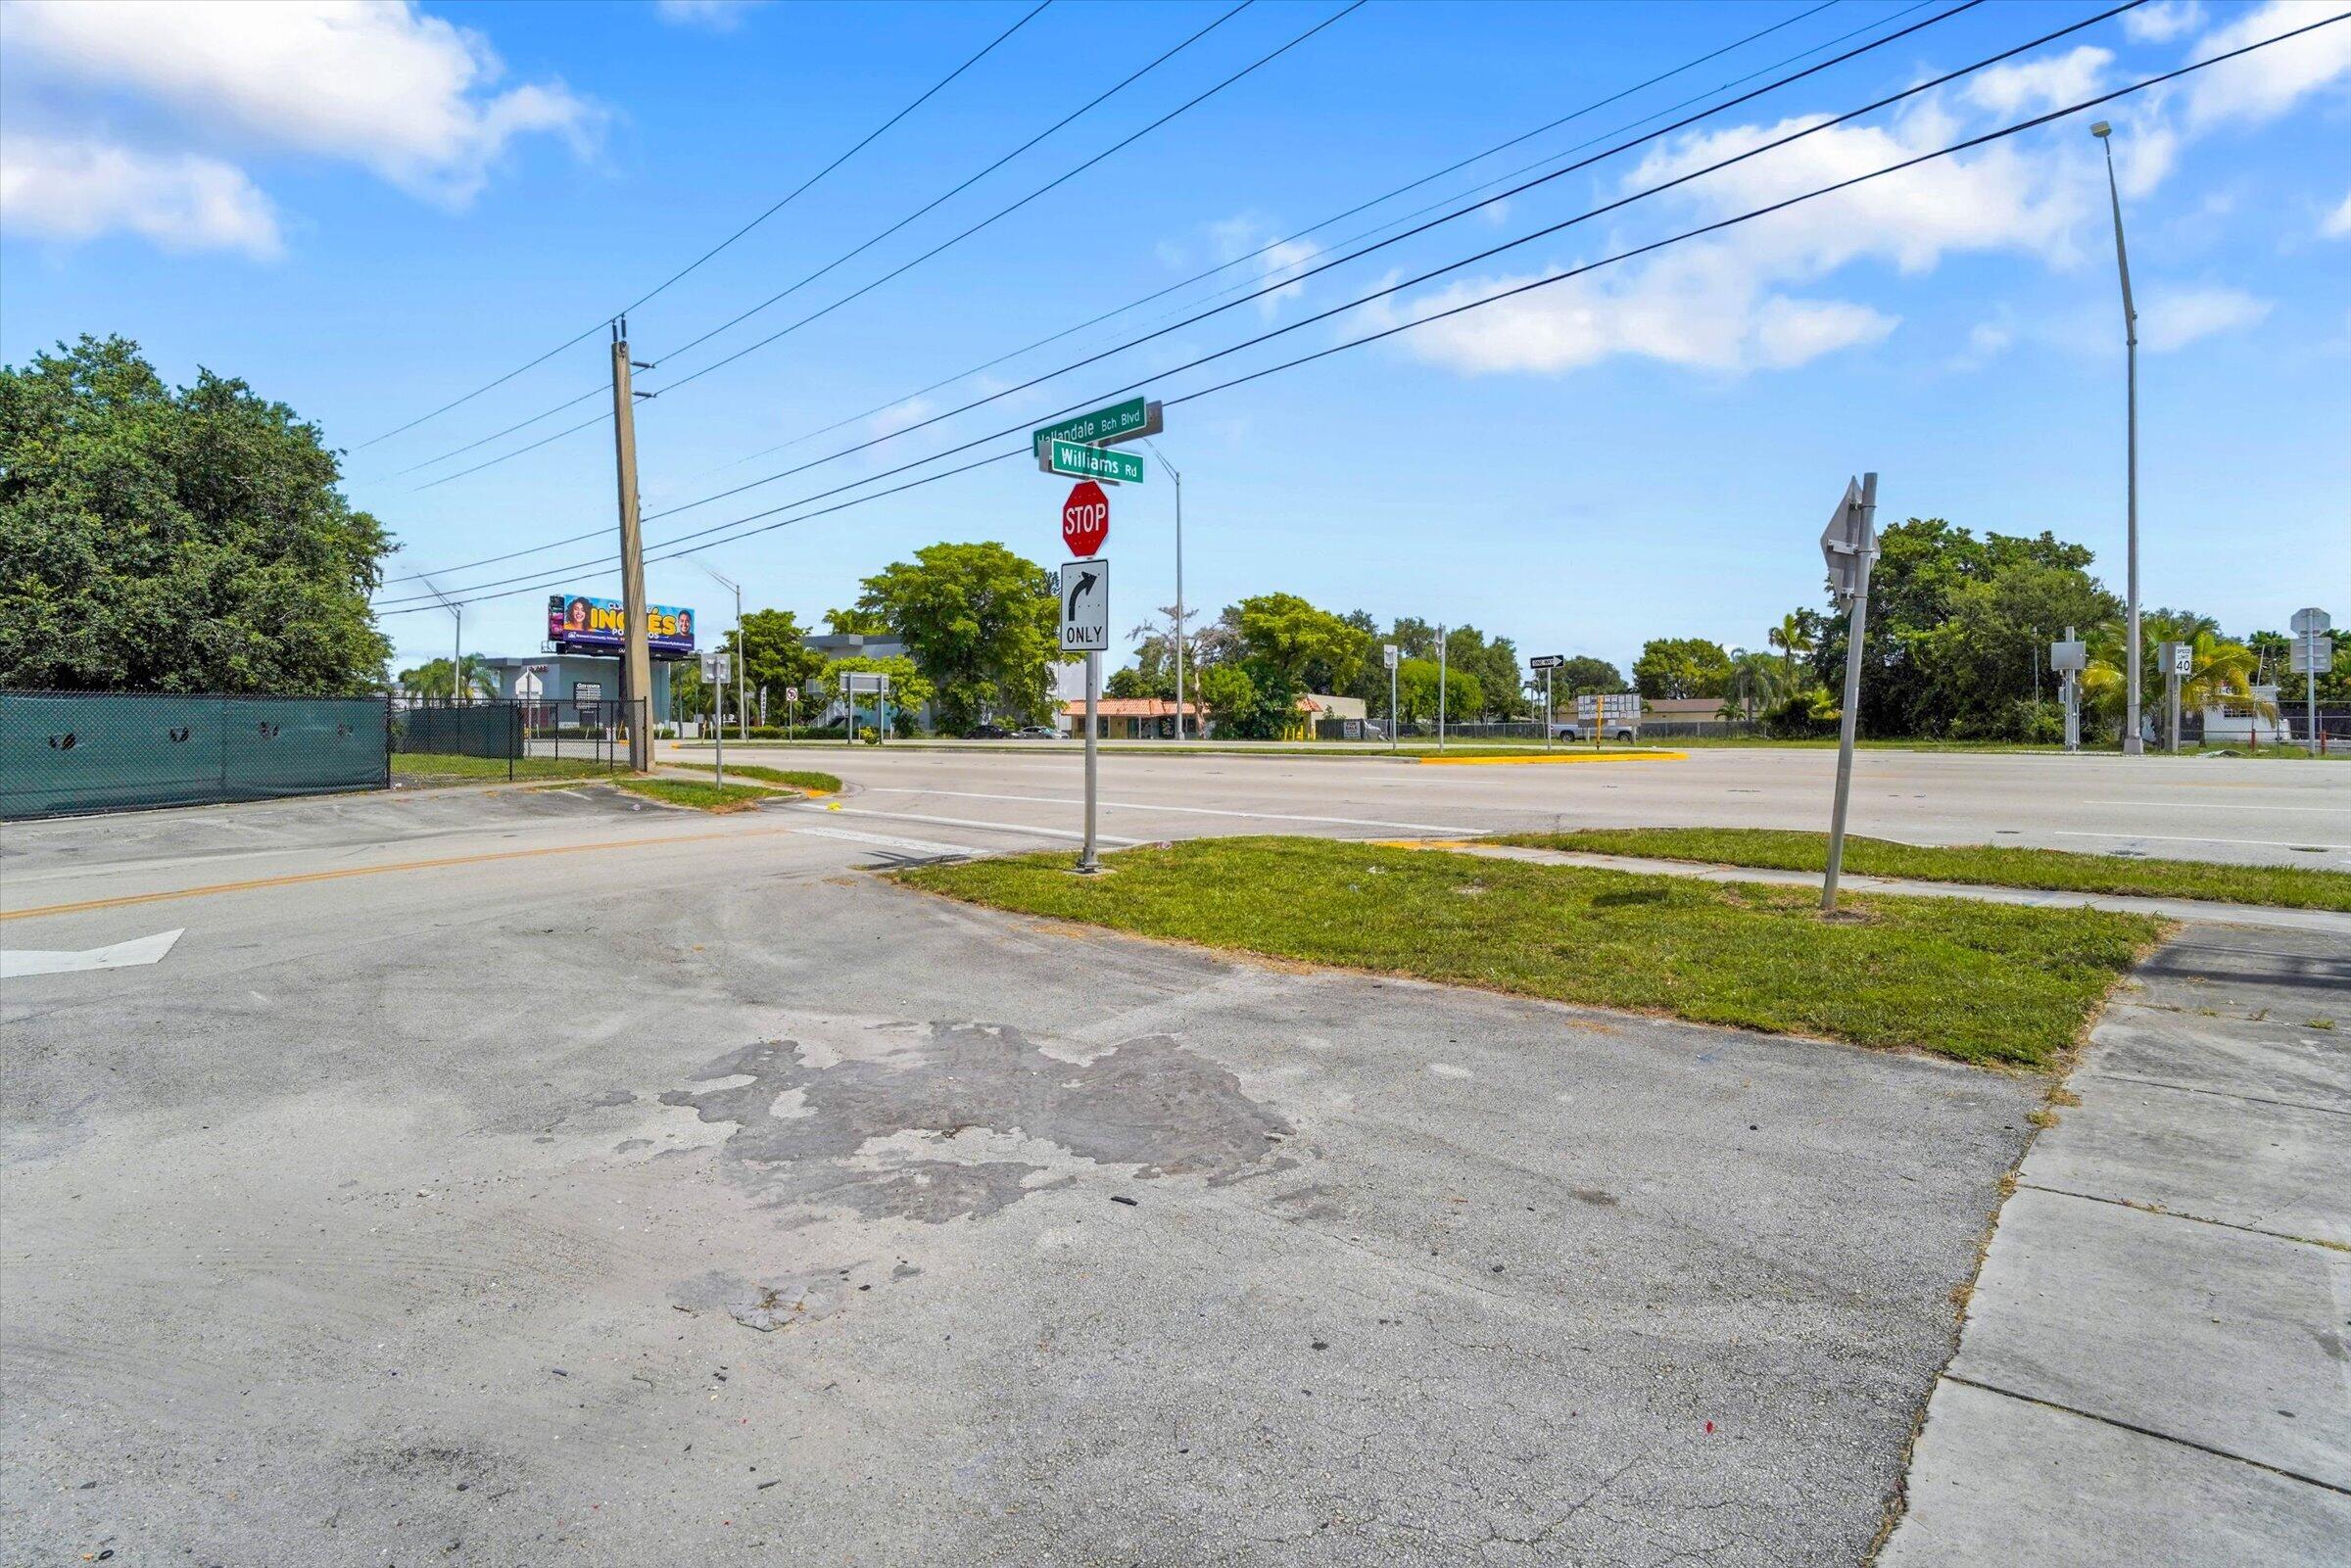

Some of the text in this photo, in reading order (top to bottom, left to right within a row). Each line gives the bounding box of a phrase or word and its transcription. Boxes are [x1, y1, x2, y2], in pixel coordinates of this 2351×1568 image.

[1101, 418, 1117, 432] Bch
[1121, 409, 1140, 426] Blvd
[1061, 447, 1137, 477] Williams Rd
[1065, 502, 1106, 536] STOP
[1066, 625, 1103, 643] ONLY
[2176, 660, 2190, 671] 40
